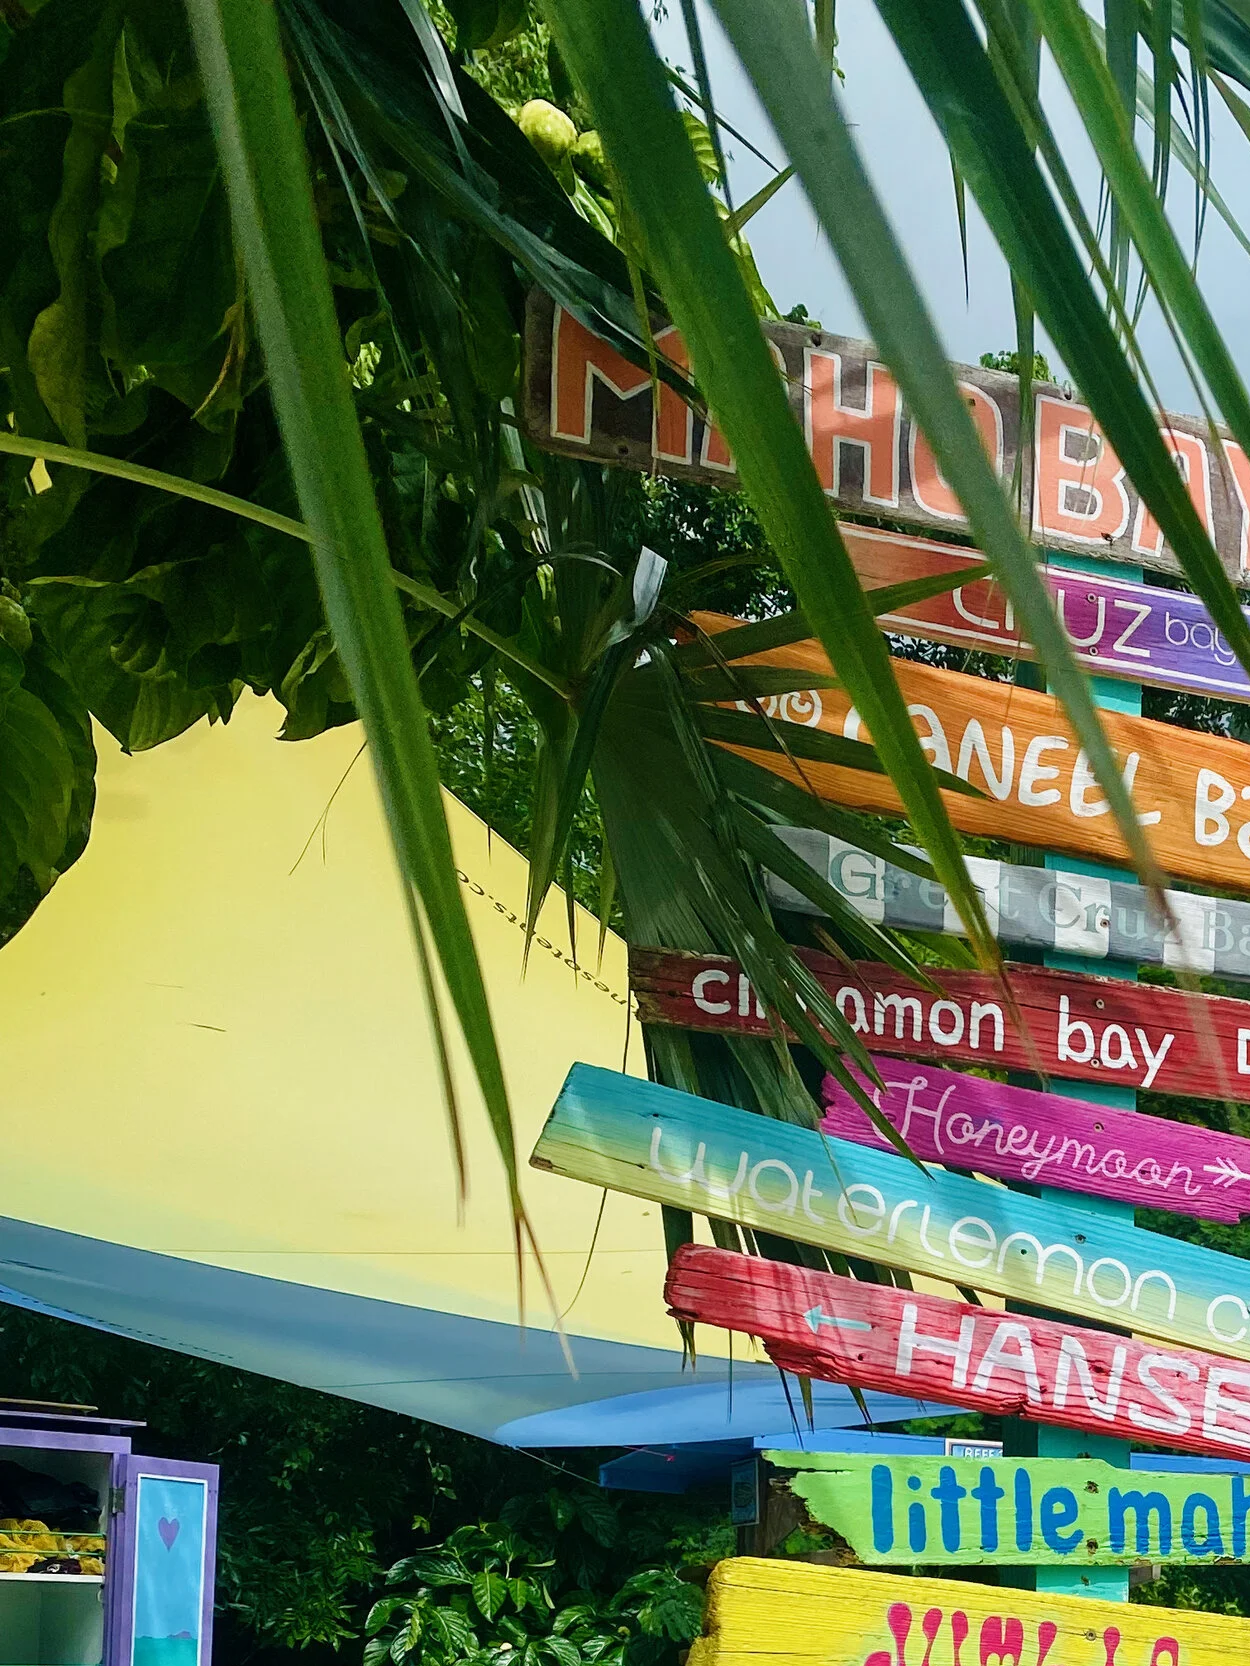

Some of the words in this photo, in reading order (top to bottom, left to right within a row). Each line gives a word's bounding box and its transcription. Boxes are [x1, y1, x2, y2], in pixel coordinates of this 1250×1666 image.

[550, 302, 1003, 523] MHO
[952, 573, 1152, 658] CUZ
[1165, 611, 1239, 667] bay
[829, 849, 1023, 919] Gret
[692, 968, 1005, 1052] ciamon
[1056, 994, 1175, 1089] bay
[871, 1075, 1203, 1196] Honeymoon
[870, 1463, 1086, 1555] little
